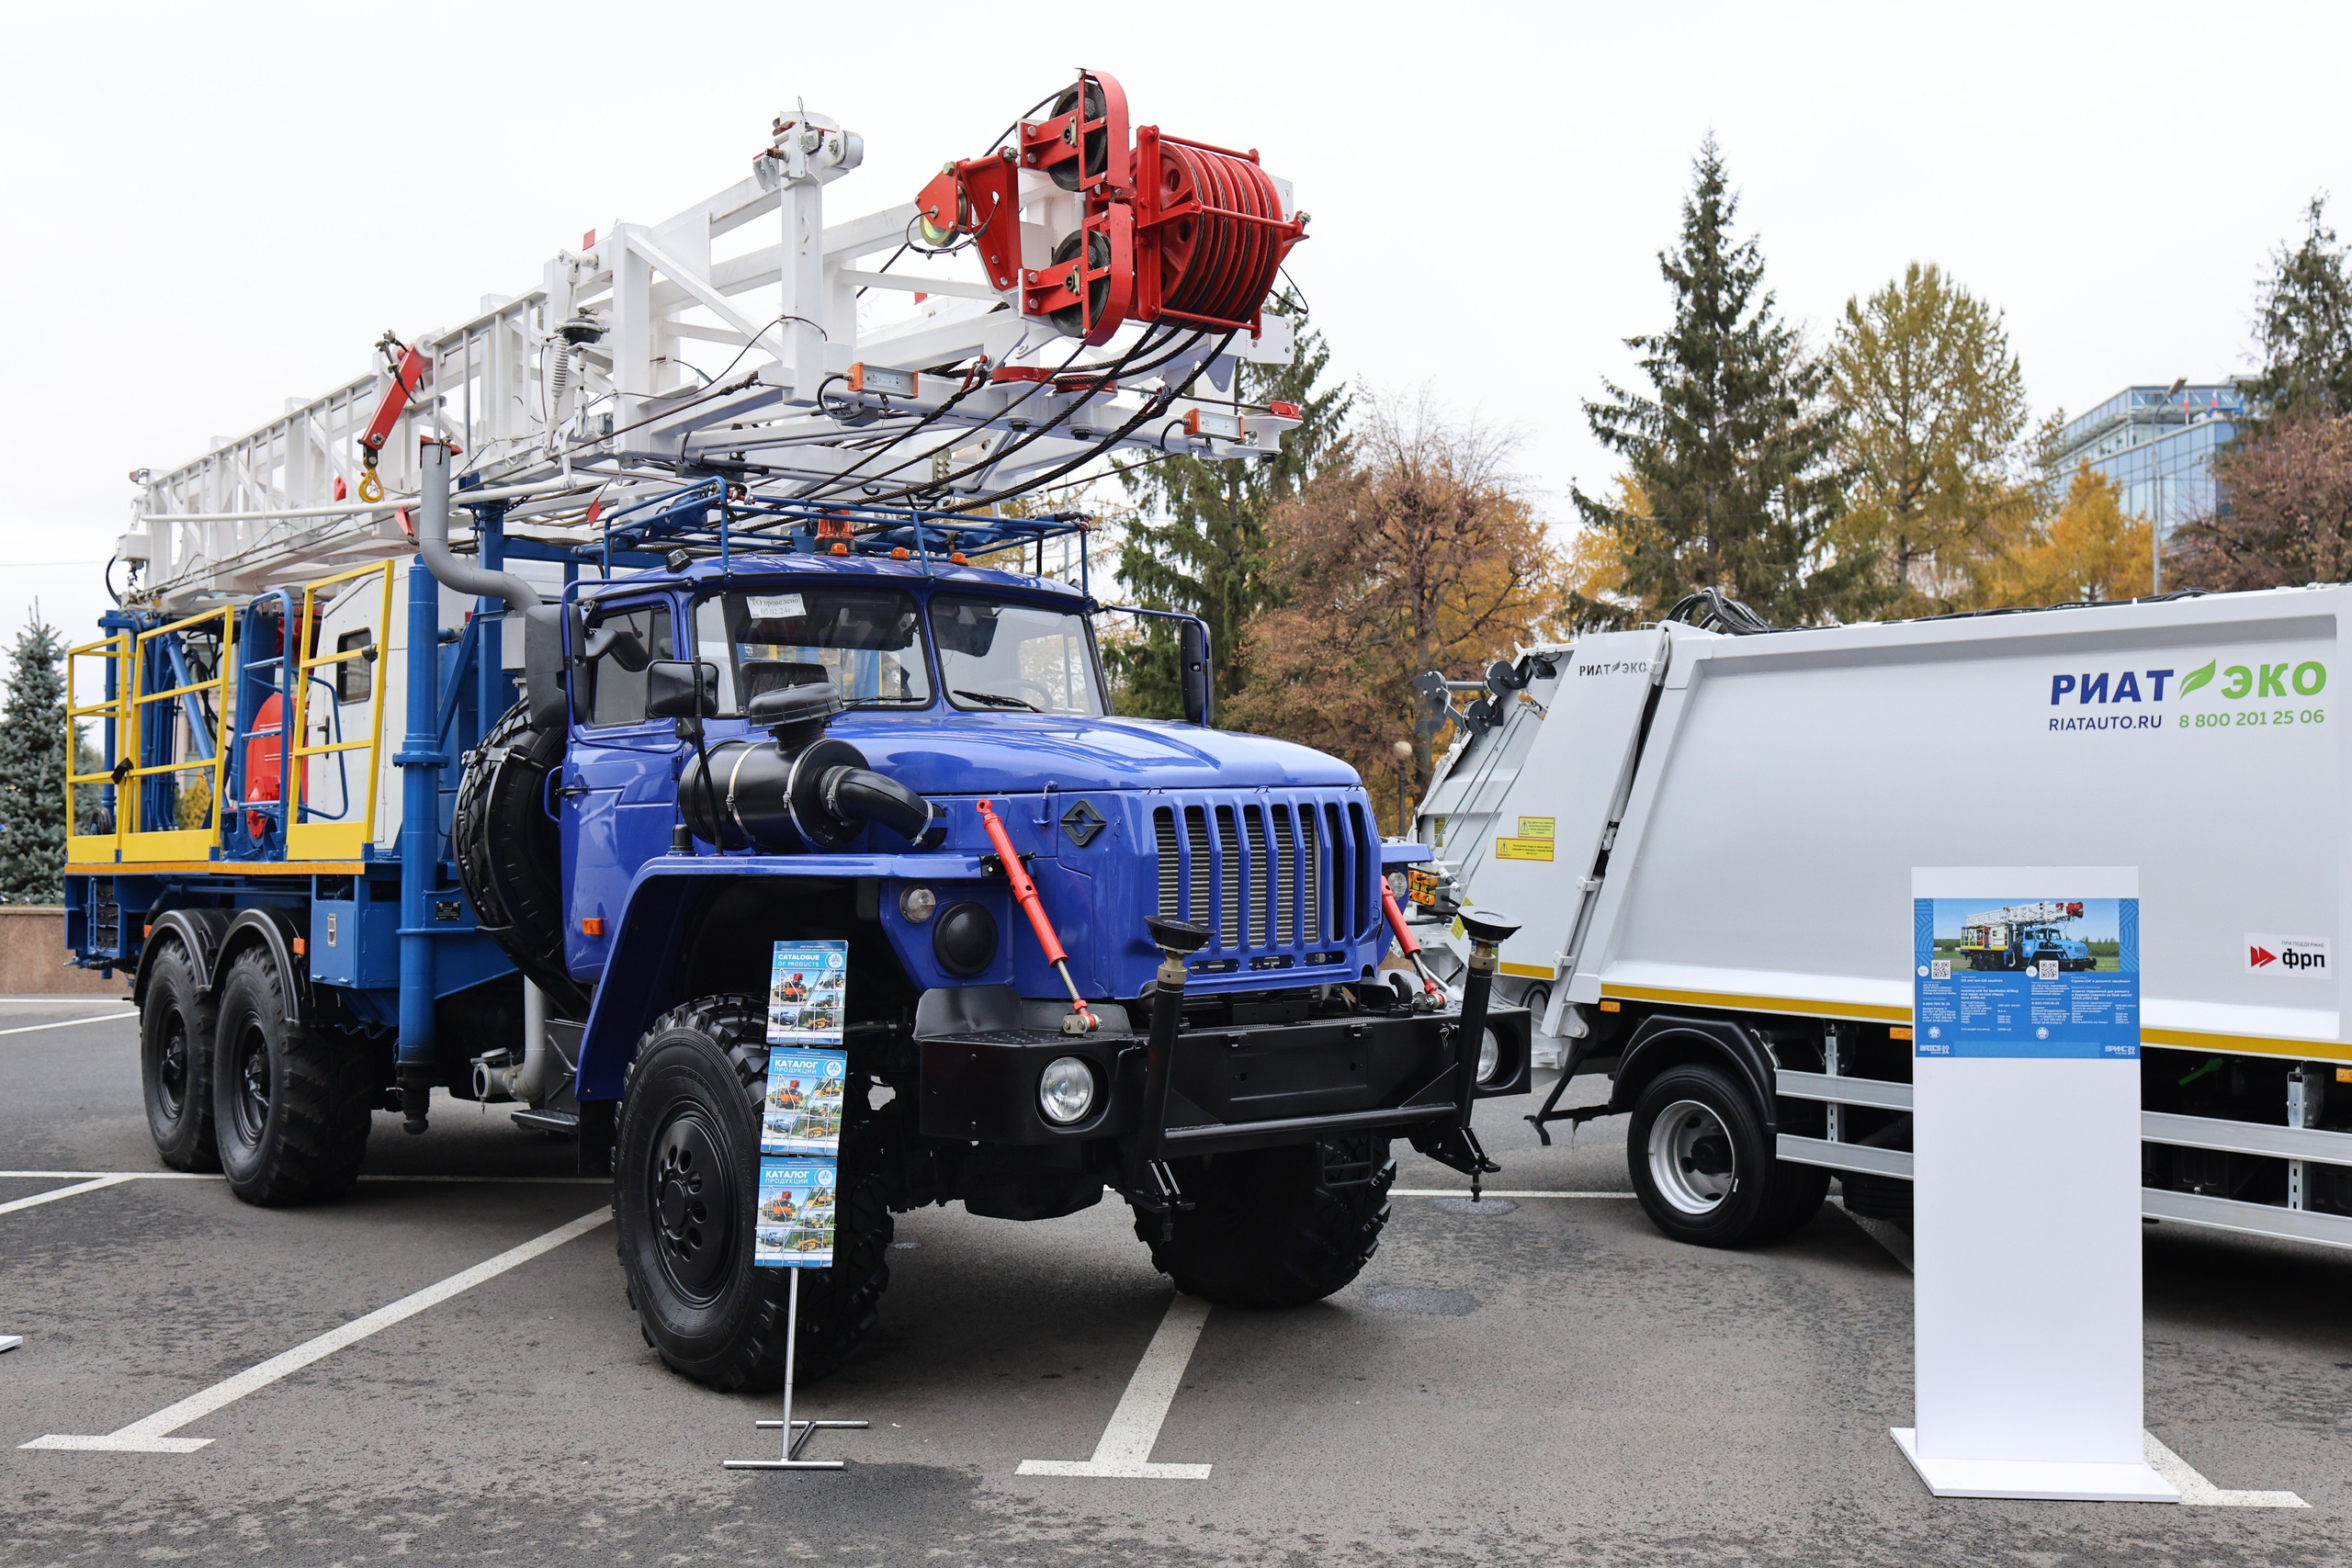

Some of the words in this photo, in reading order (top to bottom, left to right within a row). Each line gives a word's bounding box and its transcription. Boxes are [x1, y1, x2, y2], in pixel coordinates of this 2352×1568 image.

[763, 598, 799, 607] проведено
[1579, 664, 1611, 676] РИАТ
[1622, 662, 1646, 673] ЭКО
[2051, 670, 2175, 705] РИАТ
[2221, 660, 2326, 699] ЭКО
[2049, 715, 2163, 731] RIATAUTO.RU
[2179, 715, 2189, 728] 8
[2195, 713, 2231, 728] 800
[2236, 712, 2267, 726] 201
[2273, 710, 2295, 725] 25
[2300, 709, 2324, 724] 06
[2282, 948, 2325, 970] фрп
[775, 1059, 818, 1068] КАТАЛОГ
